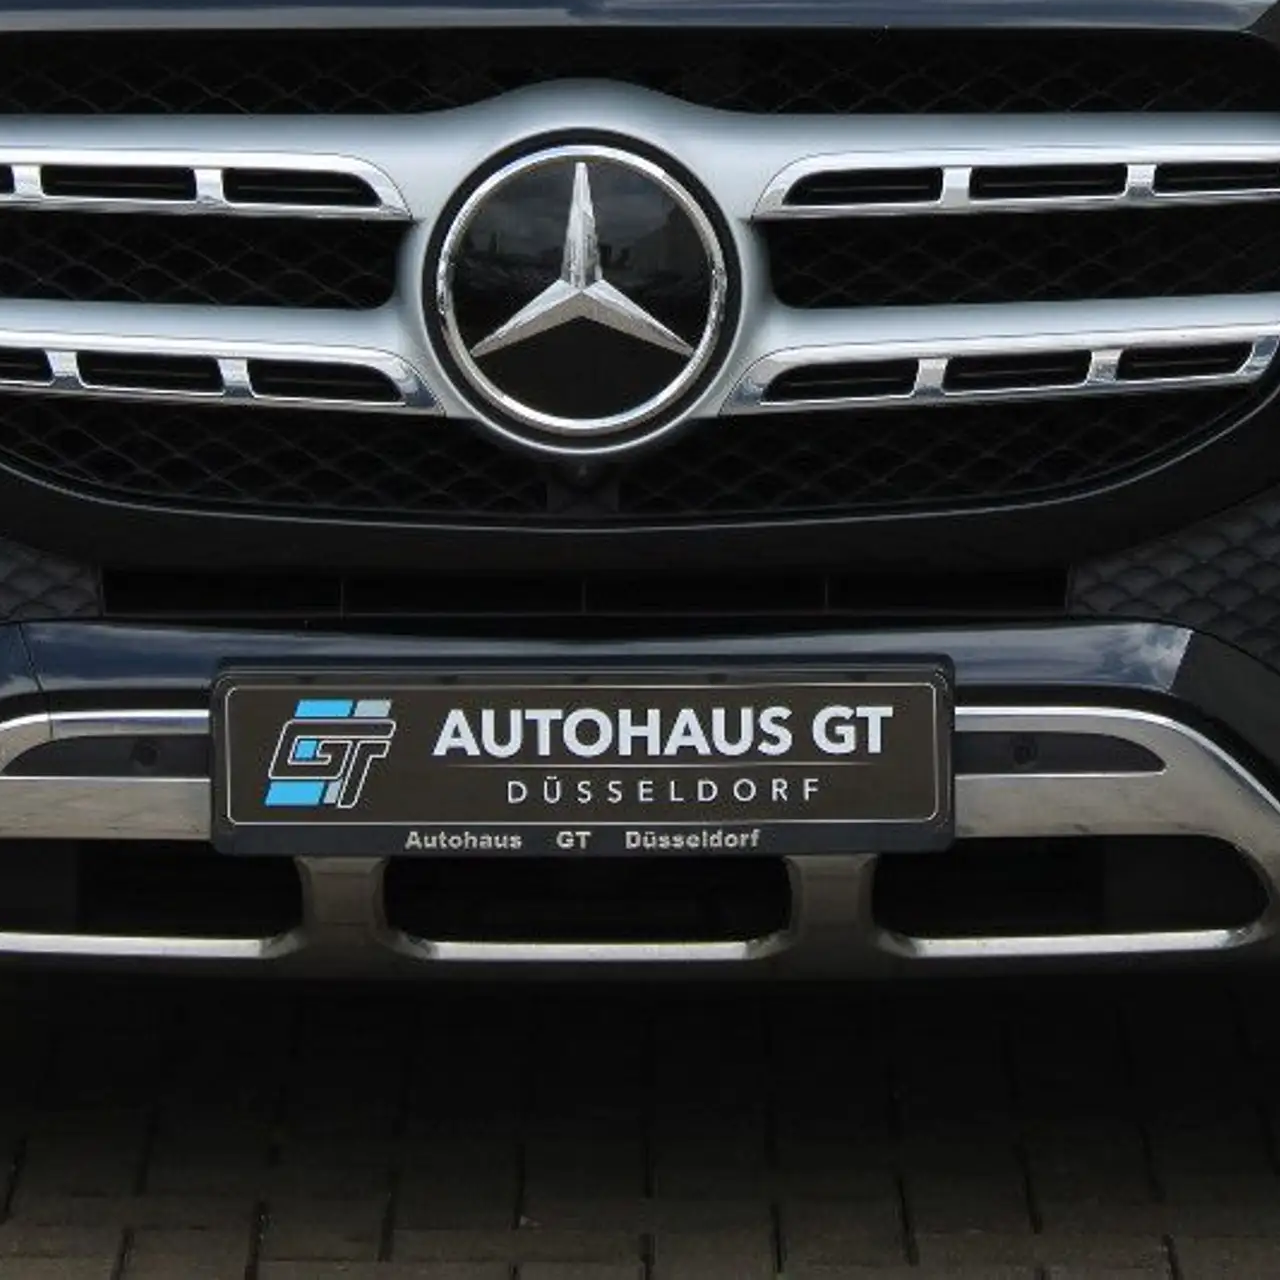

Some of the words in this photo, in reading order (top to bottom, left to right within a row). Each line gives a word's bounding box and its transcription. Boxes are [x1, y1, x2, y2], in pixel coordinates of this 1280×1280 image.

[431, 706, 793, 758] AUTOHAUS
[812, 705, 894, 754] GT
[507, 775, 819, 804] DÜSSELDORF
[404, 830, 522, 850] Autohaus
[556, 830, 592, 849] GT
[625, 827, 761, 849] Düsseldorf
